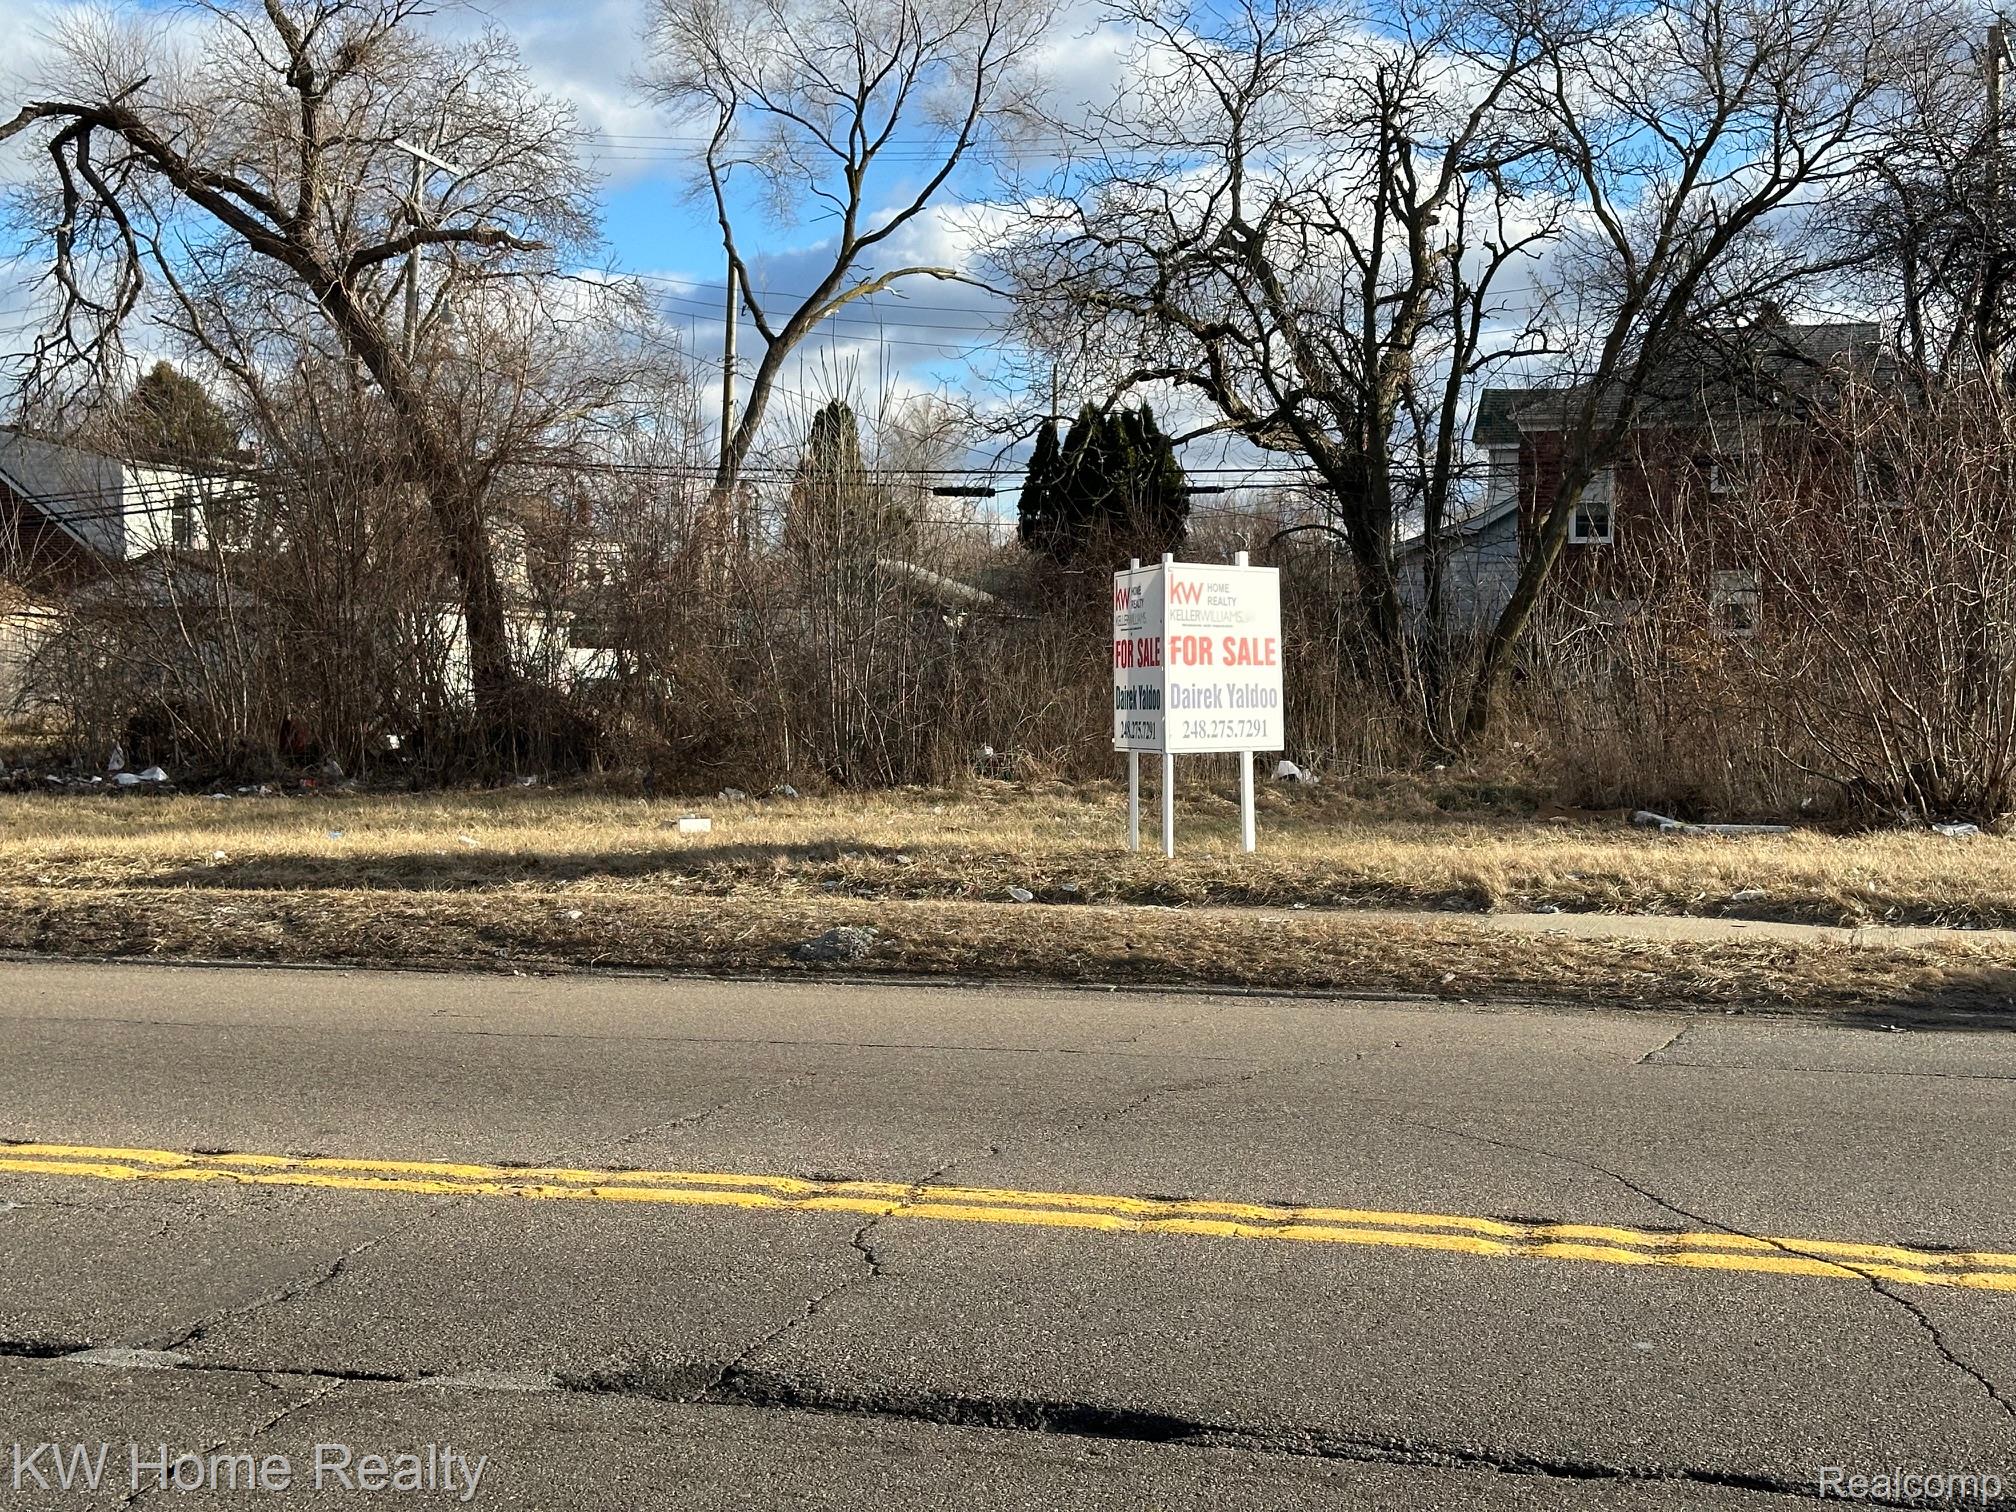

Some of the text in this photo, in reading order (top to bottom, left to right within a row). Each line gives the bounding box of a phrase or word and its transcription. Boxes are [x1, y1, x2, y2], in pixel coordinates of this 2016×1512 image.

[1207, 583, 1230, 593] HOME
[1207, 596, 1237, 607] REALTY
[1115, 637, 1161, 669] FOR SALE
[1169, 635, 1277, 667] FOR SALE
[1116, 684, 1161, 710] Dairek Yaldoo
[1170, 684, 1278, 709] Dairek Yaldoo
[1182, 719, 1268, 739] 248.275.7291
